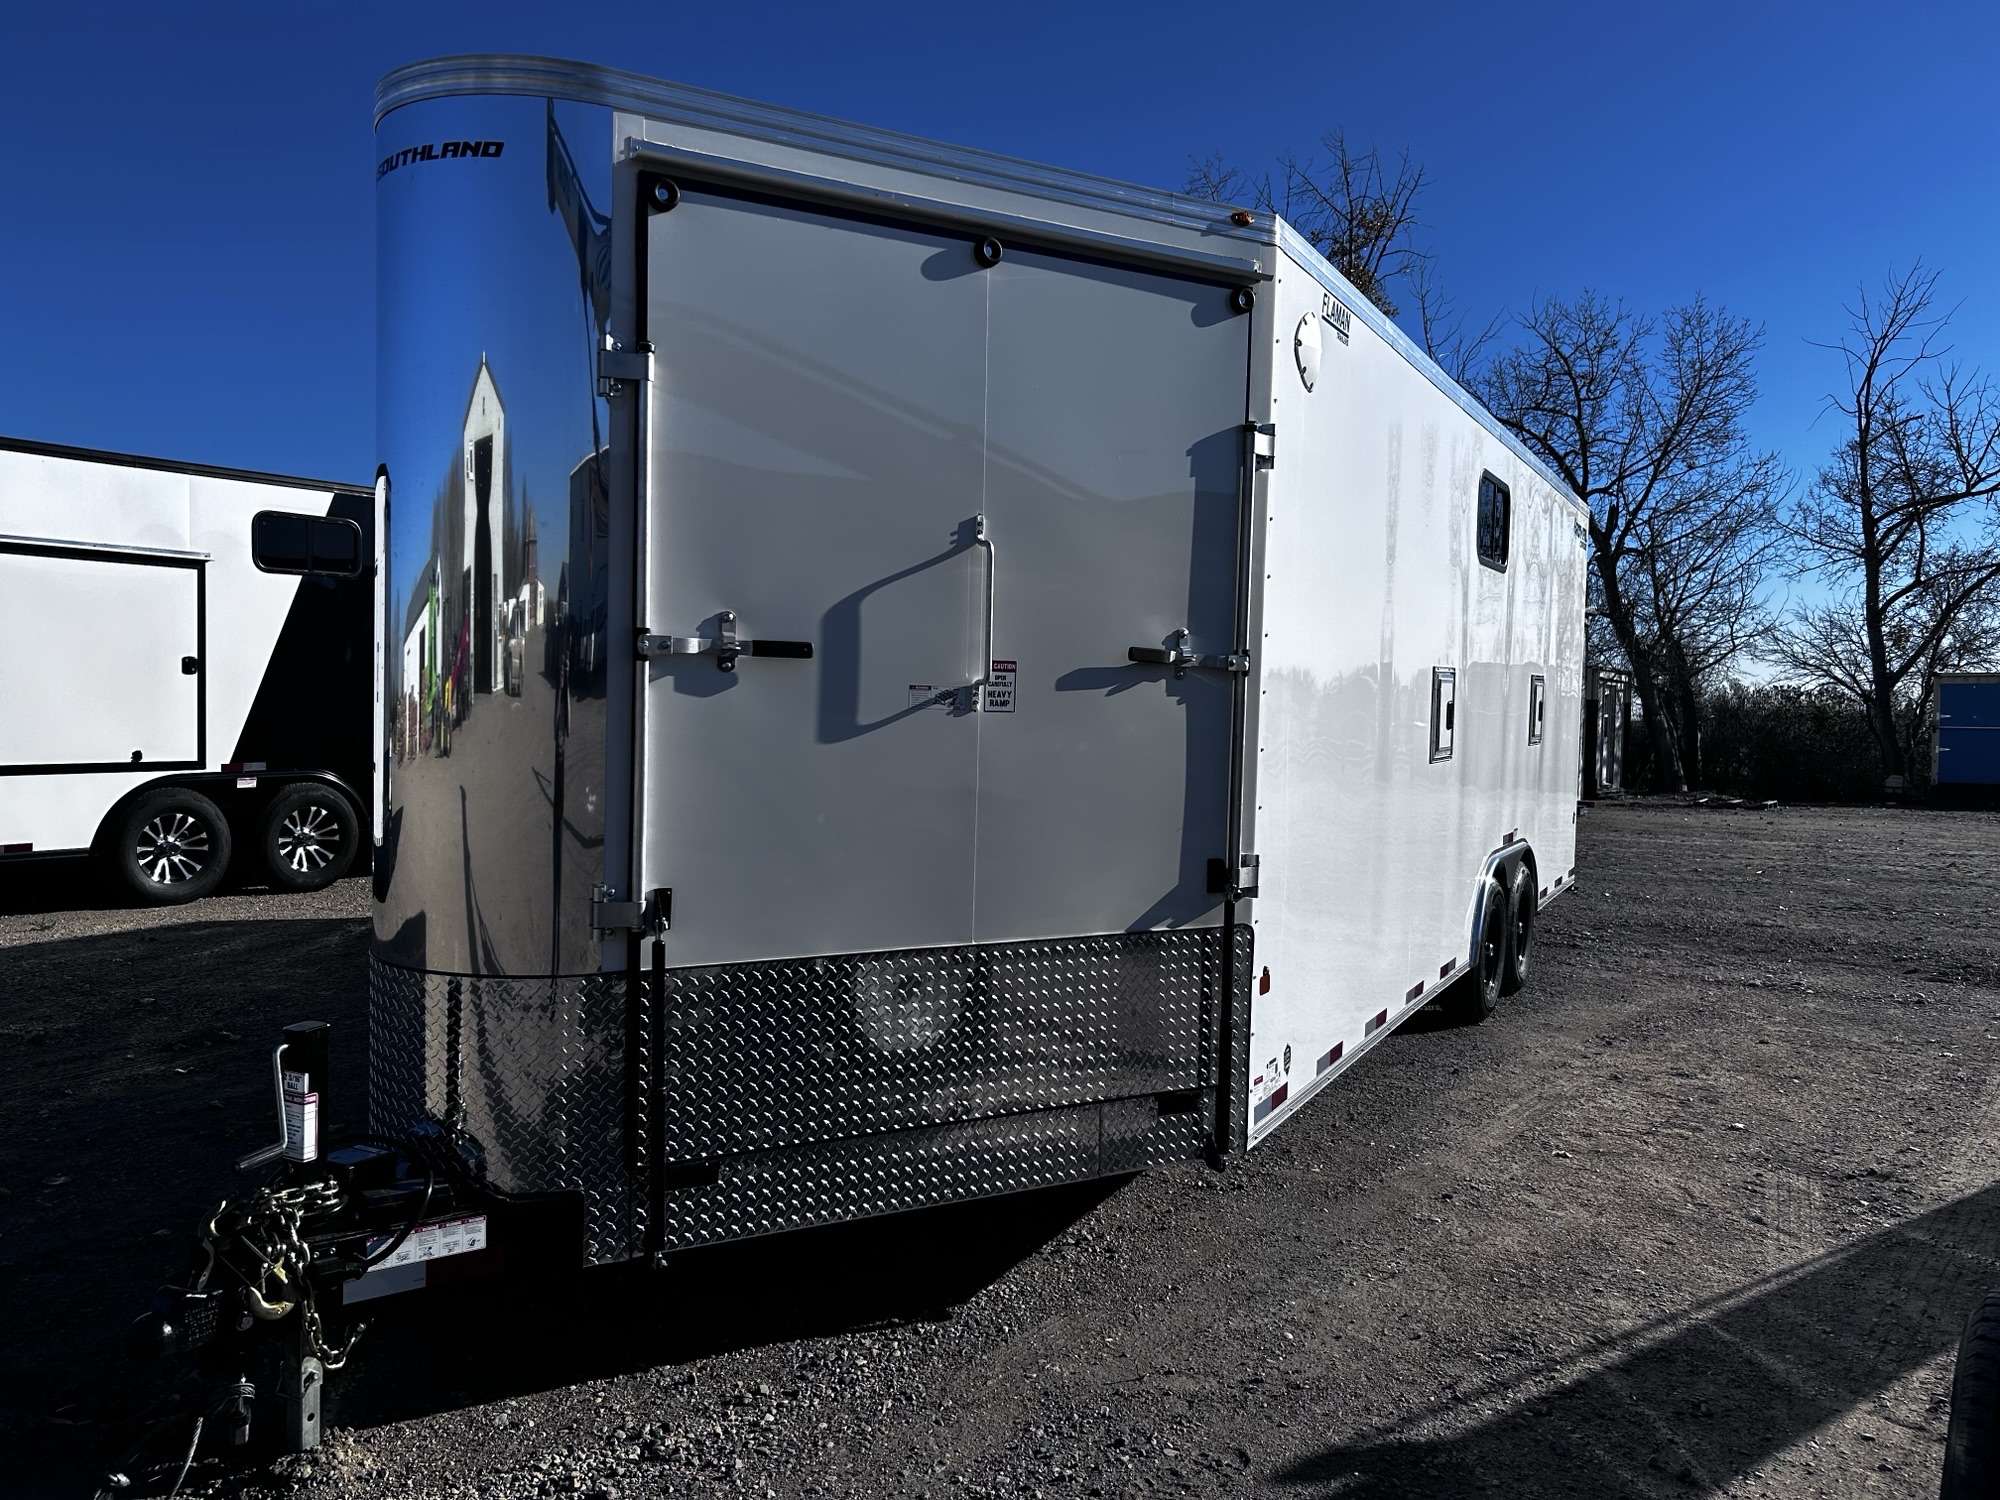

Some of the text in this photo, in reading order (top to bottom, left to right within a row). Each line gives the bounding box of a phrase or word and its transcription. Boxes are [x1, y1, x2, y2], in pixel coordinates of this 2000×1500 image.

[377, 141, 505, 180] SOUTHLAND
[1321, 292, 1351, 333] FLAMAN
[987, 690, 1012, 698] HEAVY
[989, 699, 1010, 707] RAMP
